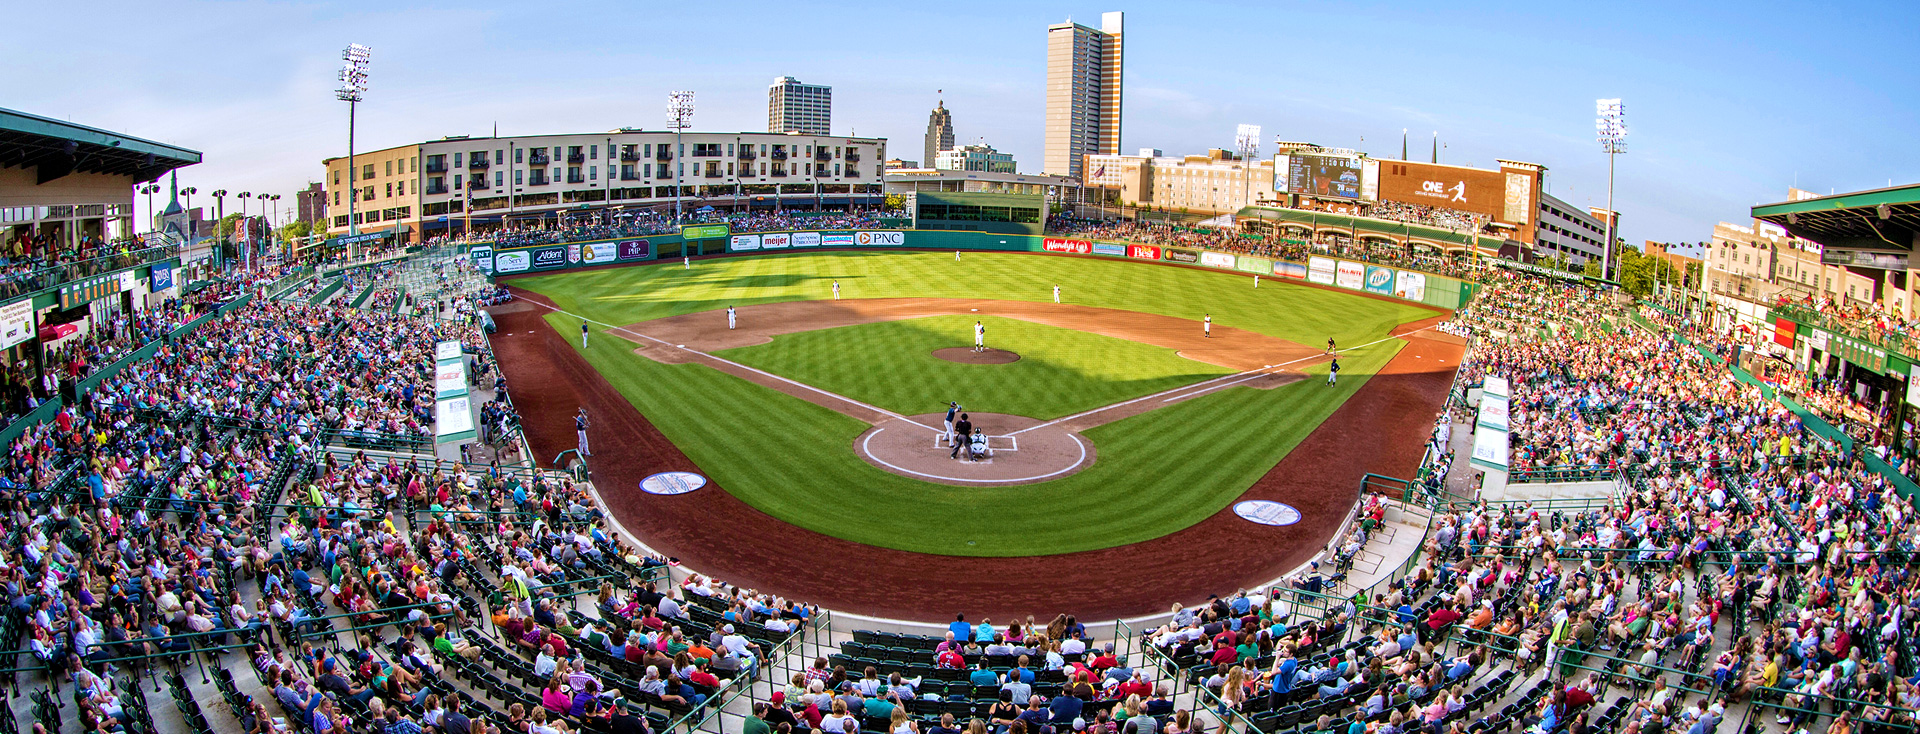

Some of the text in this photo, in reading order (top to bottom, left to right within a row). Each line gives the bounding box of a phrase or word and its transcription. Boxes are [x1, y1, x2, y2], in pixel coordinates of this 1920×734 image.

[1422, 180, 1444, 192] ONE
[765, 236, 787, 246] meijer
[874, 233, 900, 244] PNC
[1047, 239, 1075, 252] Wendy's
[539, 250, 562, 259] Afdent
[1134, 247, 1154, 258] Best
[1506, 261, 1533, 271] UNIVERSITY
[1533, 266, 1552, 275] PICNIC
[1553, 270, 1580, 280] PAVILION
